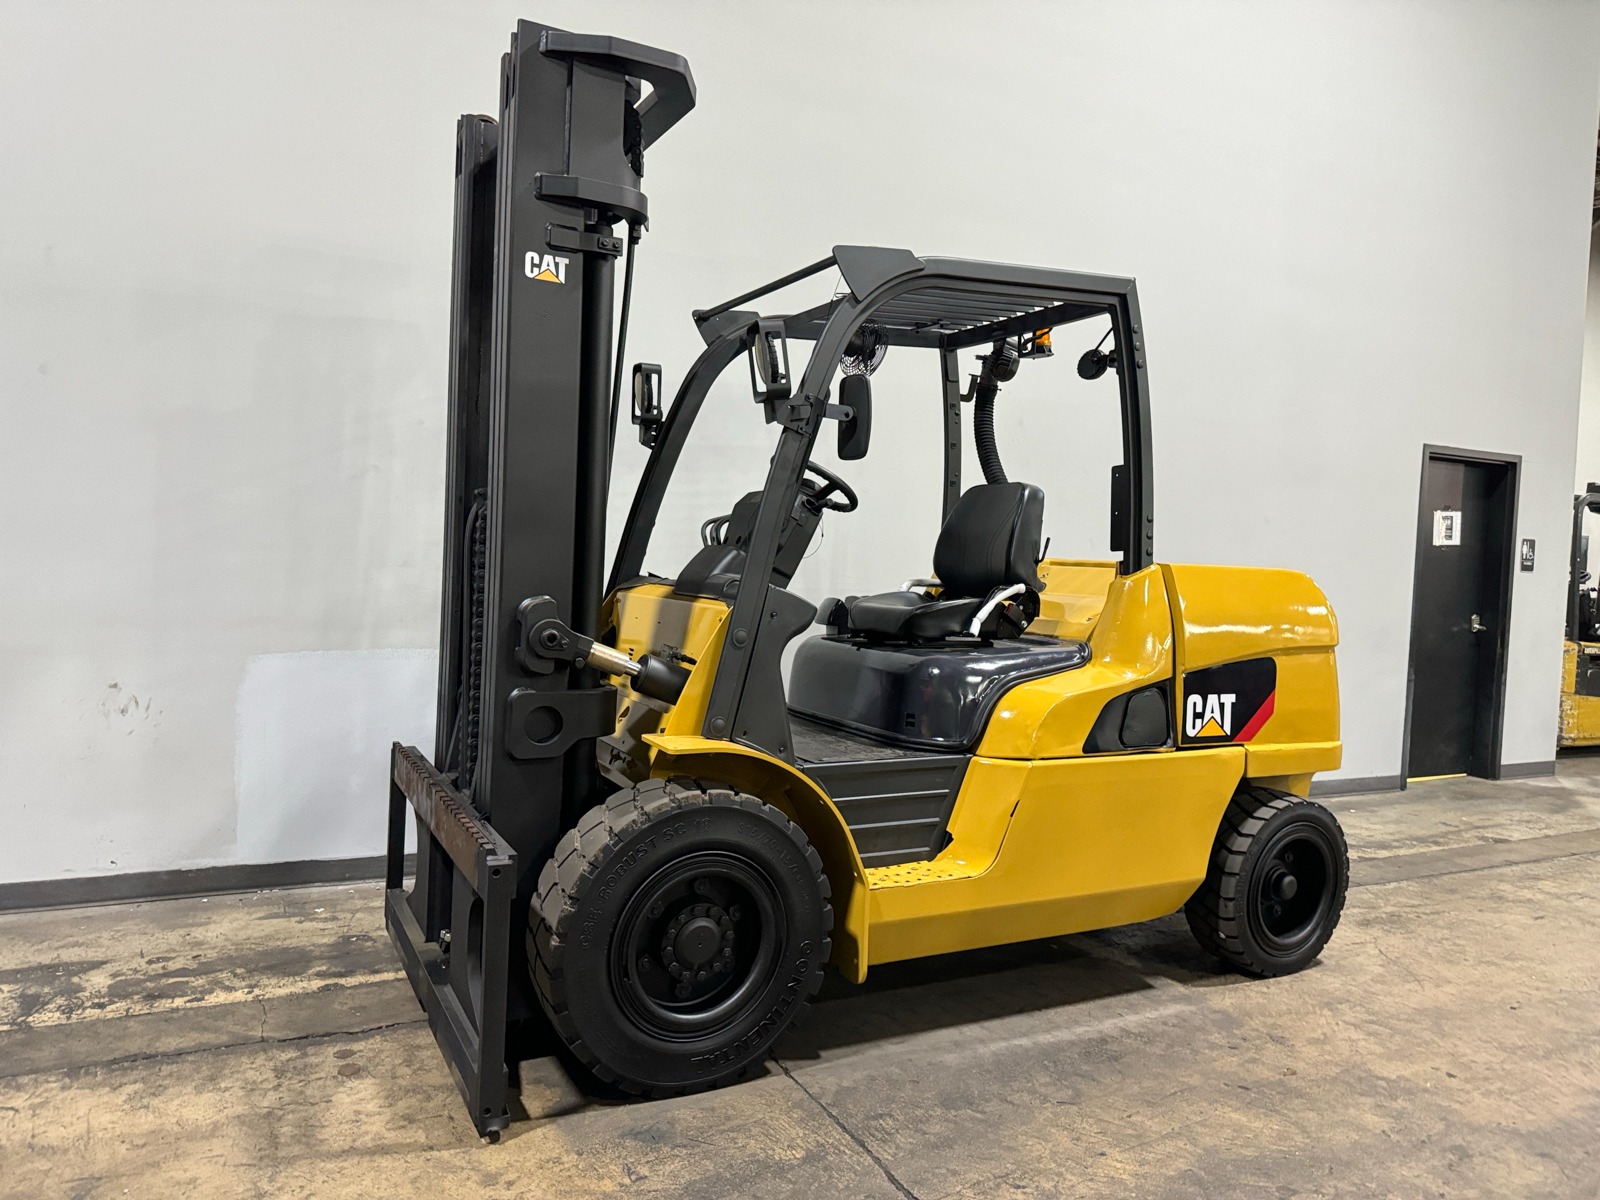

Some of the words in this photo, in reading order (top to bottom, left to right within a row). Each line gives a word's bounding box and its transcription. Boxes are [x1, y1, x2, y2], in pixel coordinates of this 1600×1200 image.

[524, 251, 570, 285] CAT
[1185, 693, 1236, 737] CAT
[597, 836, 658, 902] ROBUST
[662, 822, 687, 841] SC
[690, 940, 814, 1074] CONTINENTAL
